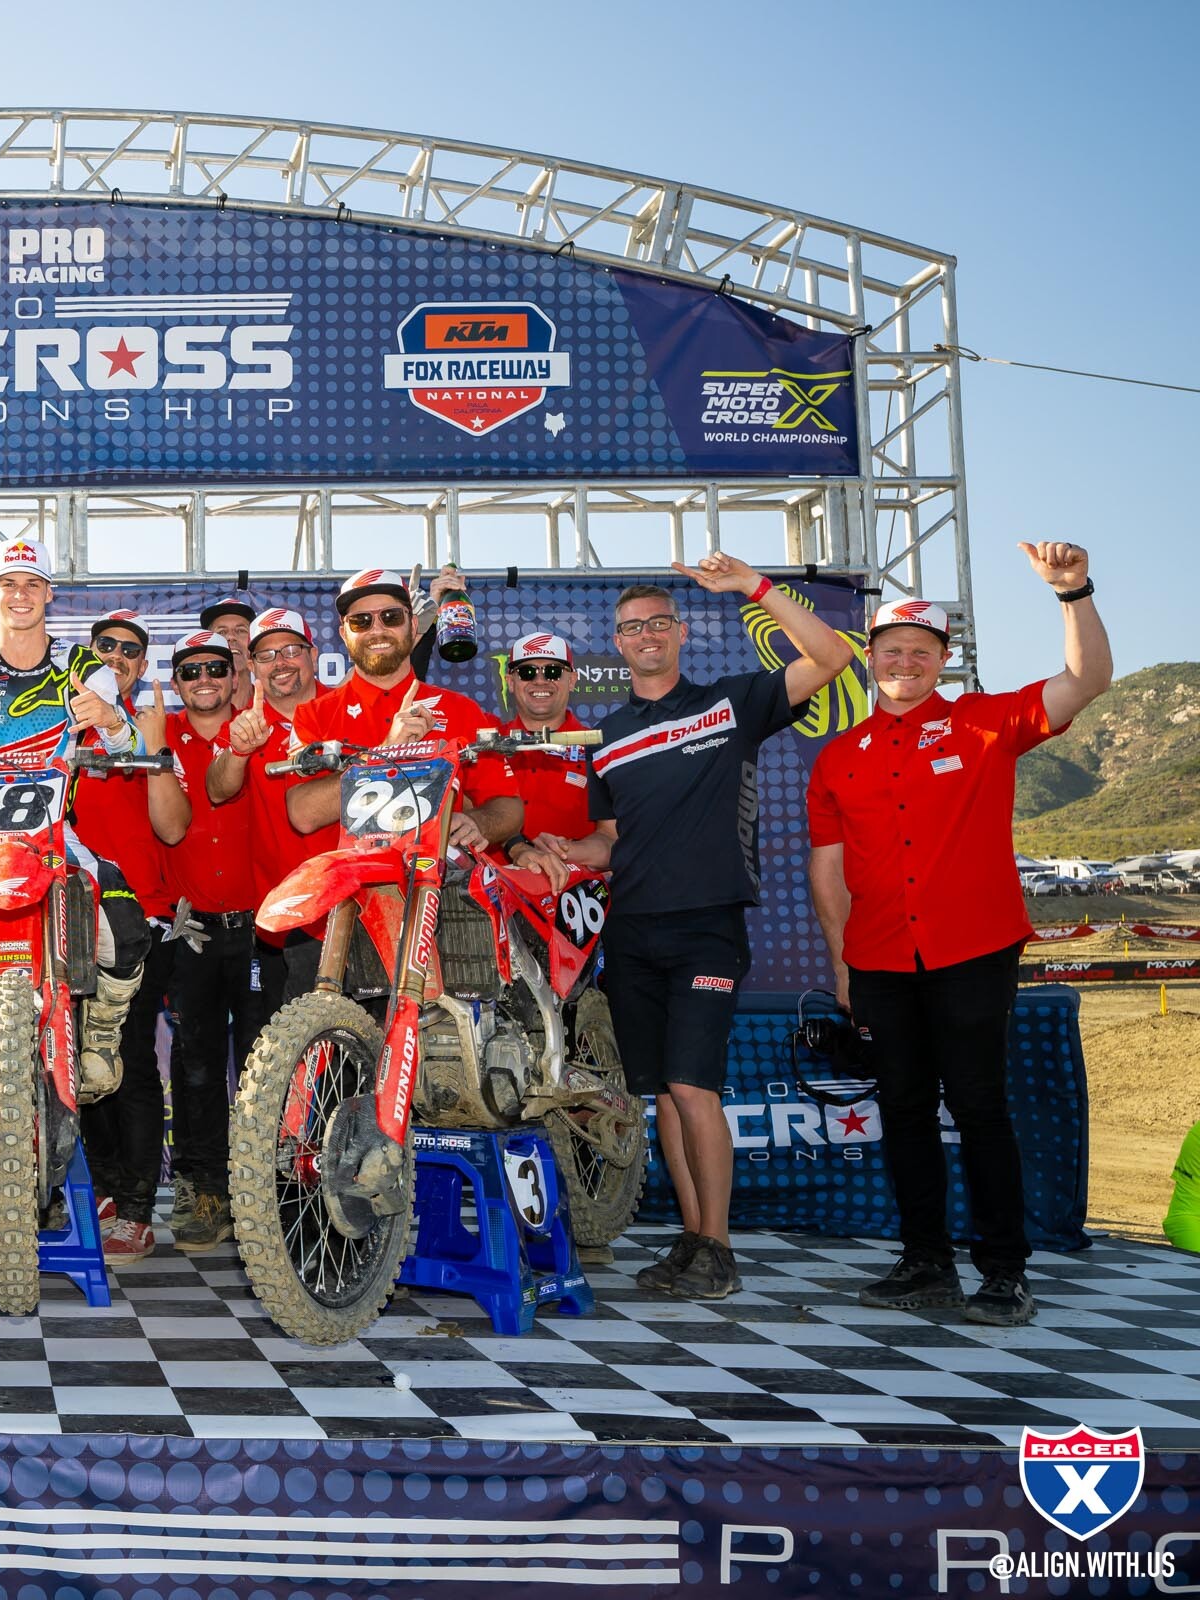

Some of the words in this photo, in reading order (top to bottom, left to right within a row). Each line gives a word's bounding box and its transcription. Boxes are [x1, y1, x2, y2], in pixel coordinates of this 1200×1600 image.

[9, 227, 105, 264] PRO
[8, 266, 105, 284] RACING
[444, 321, 509, 342] KTM
[403, 361, 443, 381] FOX
[447, 359, 551, 381] RACEWAY
[426, 391, 529, 401] NATIONAL
[701, 381, 784, 397] SUPER
[706, 397, 780, 411] MOTO
[701, 411, 781, 425] CROSS
[703, 432, 750, 442] WORLD
[752, 432, 848, 445] CHAMPIONSHIP
[4, 552, 20, 563] Red
[21, 553, 37, 563] Bull
[891, 615, 932, 626] HONDA
[523, 649, 555, 657] HONDA
[578, 665, 632, 683] NSTE
[572, 685, 632, 693] NERGY
[669, 708, 731, 742] SHOWA
[346, 780, 432, 833] 96
[560, 884, 605, 946] 96
[415, 891, 439, 969] SHOWA
[1045, 962, 1092, 972] MX-ATV
[1147, 960, 1196, 969] MX-ATV
[692, 975, 734, 989] SHOWA
[393, 1026, 418, 1122] DUNLOP
[414, 1136, 472, 1148] OTOCROSS
[518, 1159, 545, 1225] 3
